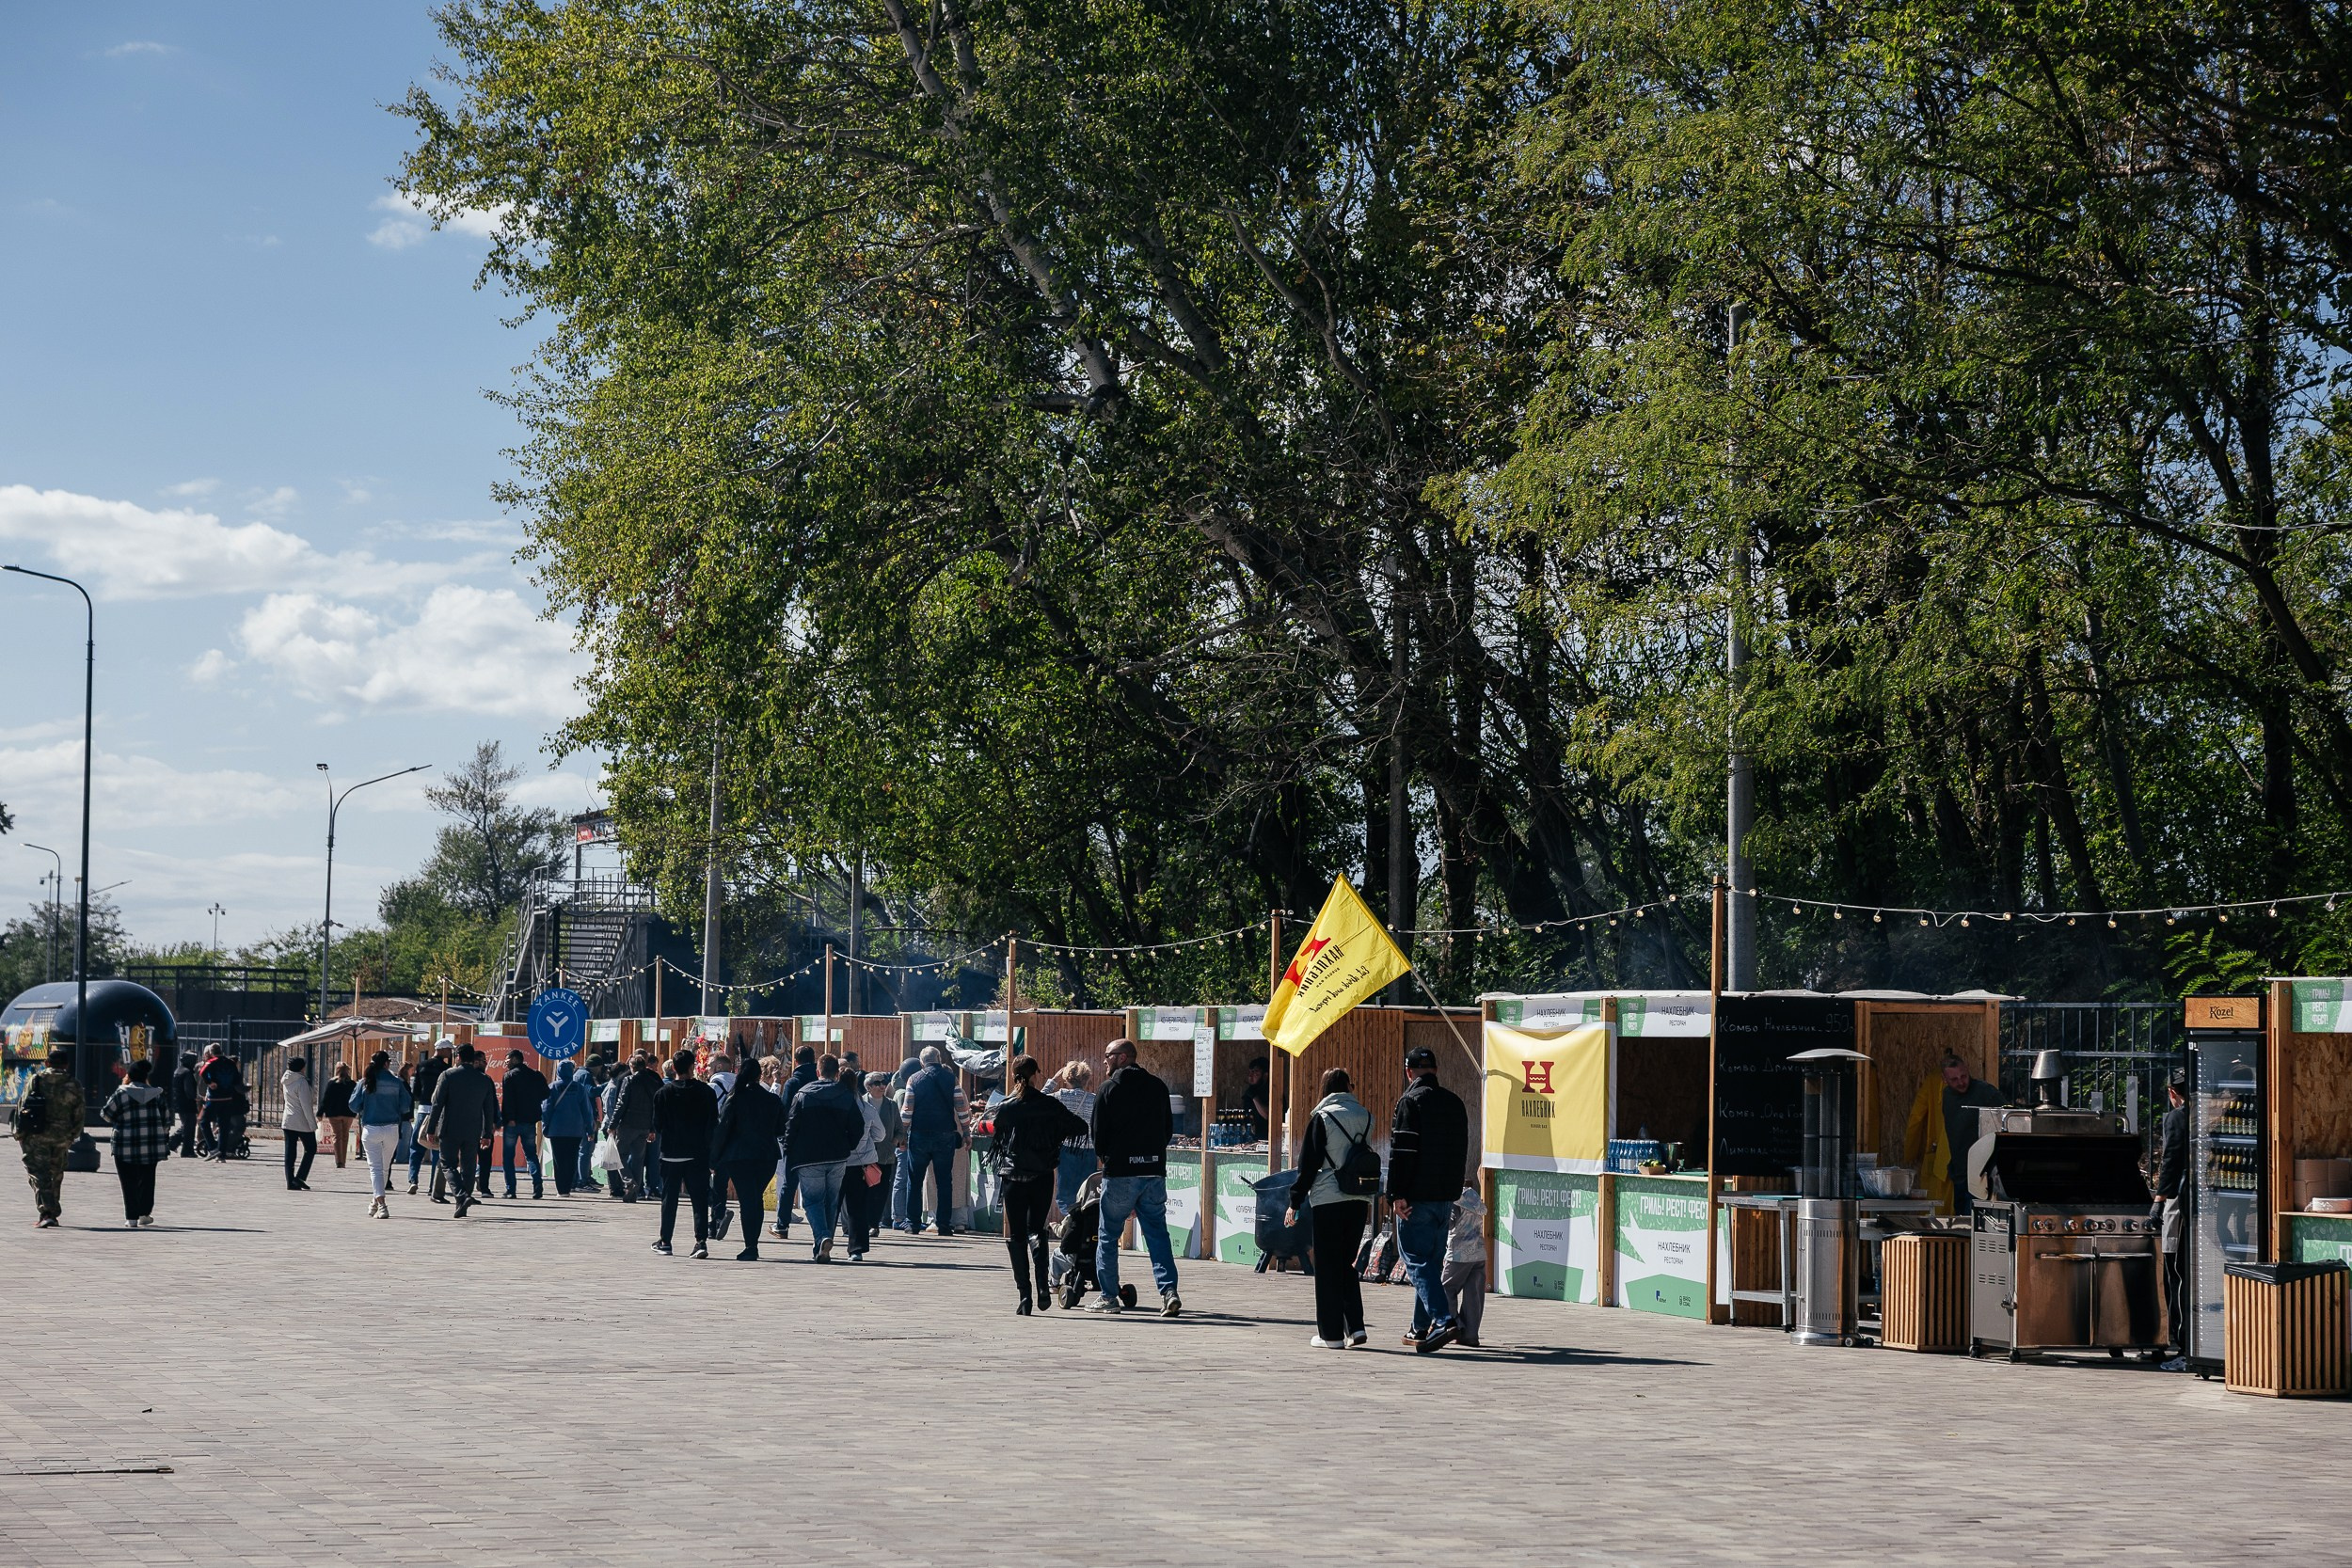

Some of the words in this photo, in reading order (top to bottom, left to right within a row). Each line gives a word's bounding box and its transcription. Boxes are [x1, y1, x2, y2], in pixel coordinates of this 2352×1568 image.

[535, 991, 579, 1007] YANKEE
[2312, 989, 2331, 999] ГРИЛЬ!
[1537, 1008, 1566, 1017] НАХЛЕБНИК
[1661, 1006, 1695, 1016] НАХЛЕБНИК
[2210, 1006, 2234, 1019] Kozel
[2312, 1002, 2327, 1012] РЕСТ!
[2312, 1014, 2328, 1025] ФЕСТ!
[535, 1041, 578, 1057] SIERRA
[1522, 1099, 1556, 1118] НАХЛЕБНИК
[1518, 1188, 1539, 1205] ГРИЛЬ!
[1541, 1189, 1558, 1207] РЕСТ!
[1560, 1189, 1581, 1208] ФЕСТ!
[1640, 1196, 1664, 1214] ГРИЛЬ!
[1666, 1199, 1686, 1217] РЕСТ!
[1688, 1200, 1708, 1220] ФЕСТ
[1534, 1230, 1563, 1241] НАХЛЕБНИК
[1540, 1243, 1557, 1252] РЕСТОРАН
[1658, 1241, 1691, 1253] НАХЛЕБНИК
[1664, 1256, 1683, 1265] РЕСТОРАН
